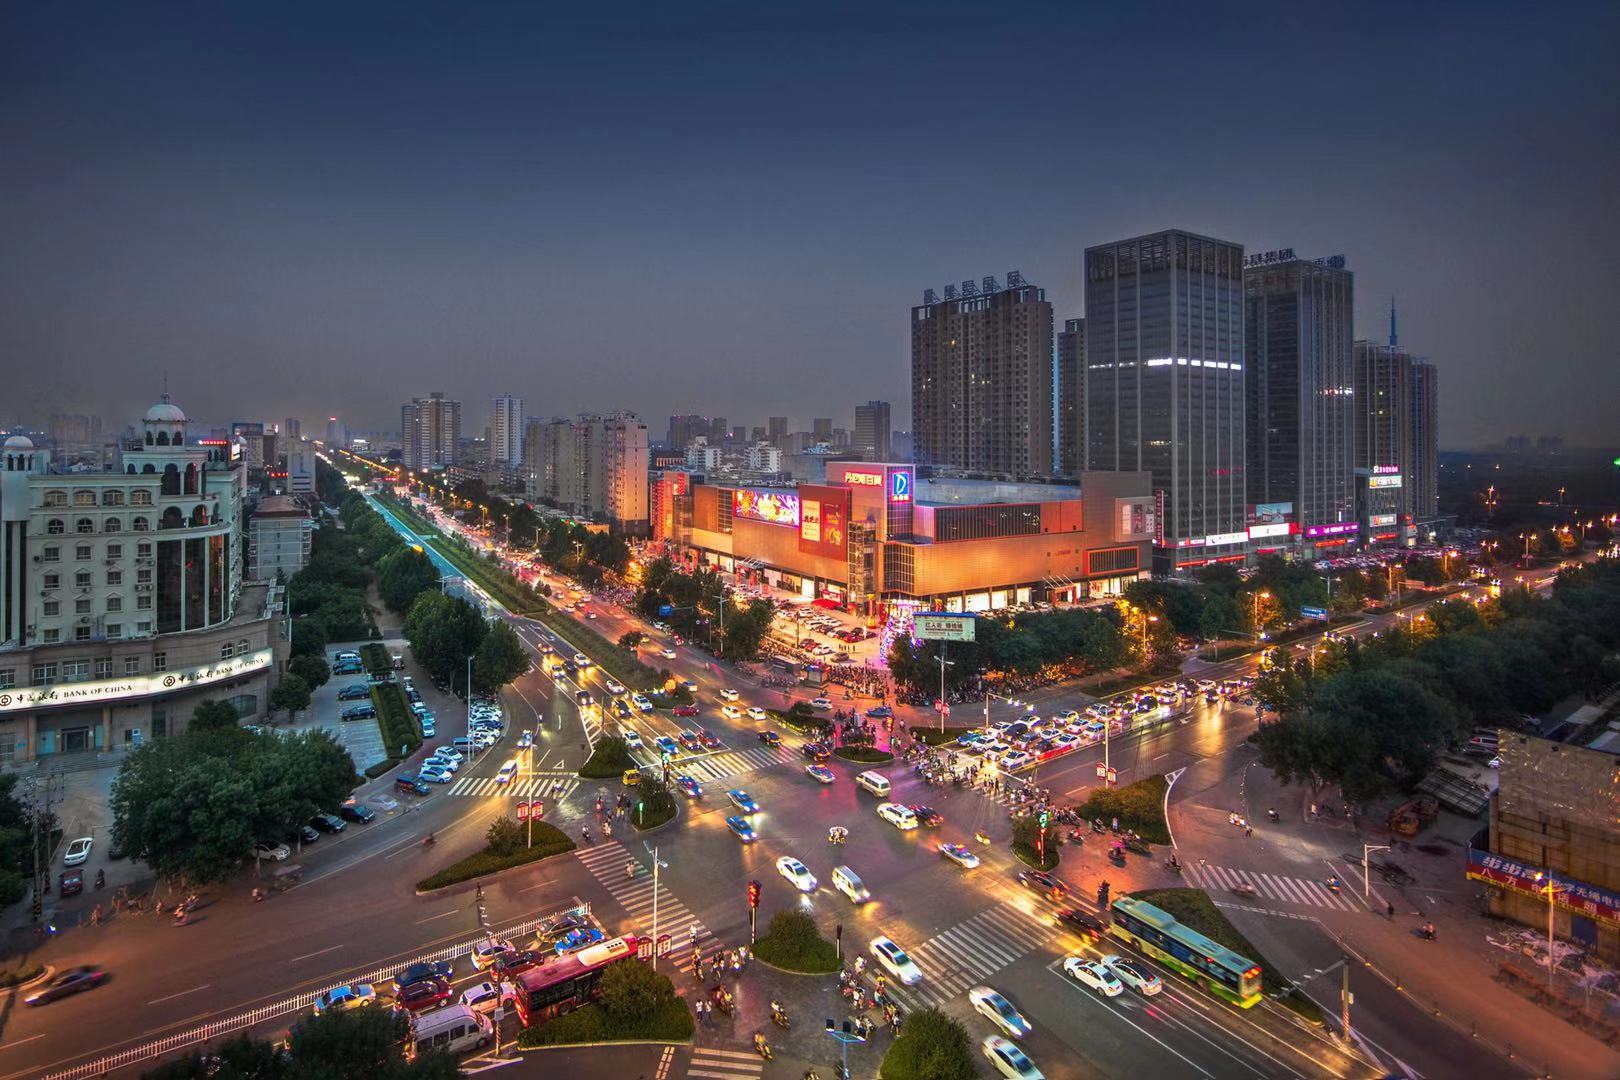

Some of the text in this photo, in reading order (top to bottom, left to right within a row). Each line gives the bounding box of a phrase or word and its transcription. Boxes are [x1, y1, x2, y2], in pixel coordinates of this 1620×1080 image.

[178, 669, 214, 683] 中国银行
[216, 666, 233, 676] BANK
[17, 691, 59, 703] 中国银行
[63, 689, 88, 698] BANK
[104, 685, 133, 694] CHINA
